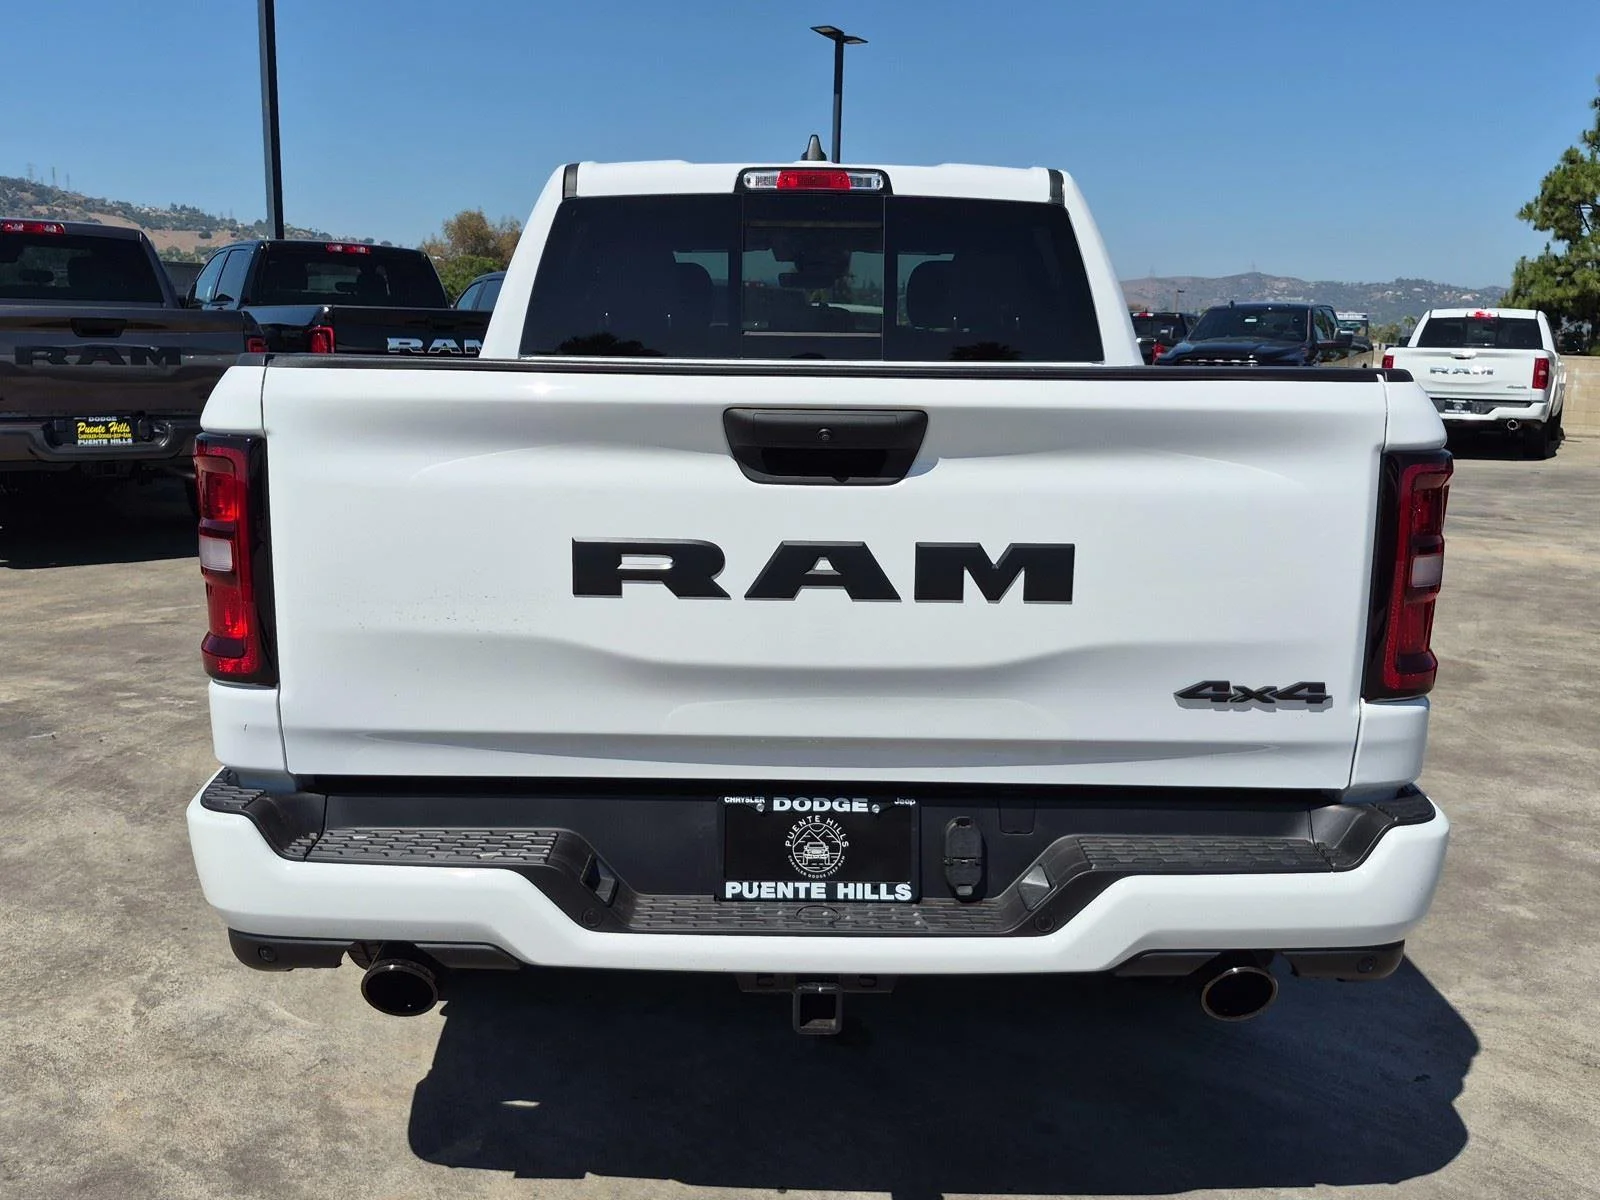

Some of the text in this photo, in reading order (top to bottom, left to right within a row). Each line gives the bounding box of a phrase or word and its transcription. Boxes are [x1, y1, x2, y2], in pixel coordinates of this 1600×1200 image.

[14, 346, 181, 365] RAM
[76, 422, 131, 433] Puente Hills
[571, 537, 1075, 604] RAM
[1173, 680, 1330, 706] 4x4
[724, 796, 765, 804] CHRYSLER
[773, 797, 869, 812] DODGE
[894, 797, 916, 806] Jeep
[784, 815, 850, 848] PUENTE HILLS
[725, 881, 912, 900] PUENTE HILLS
